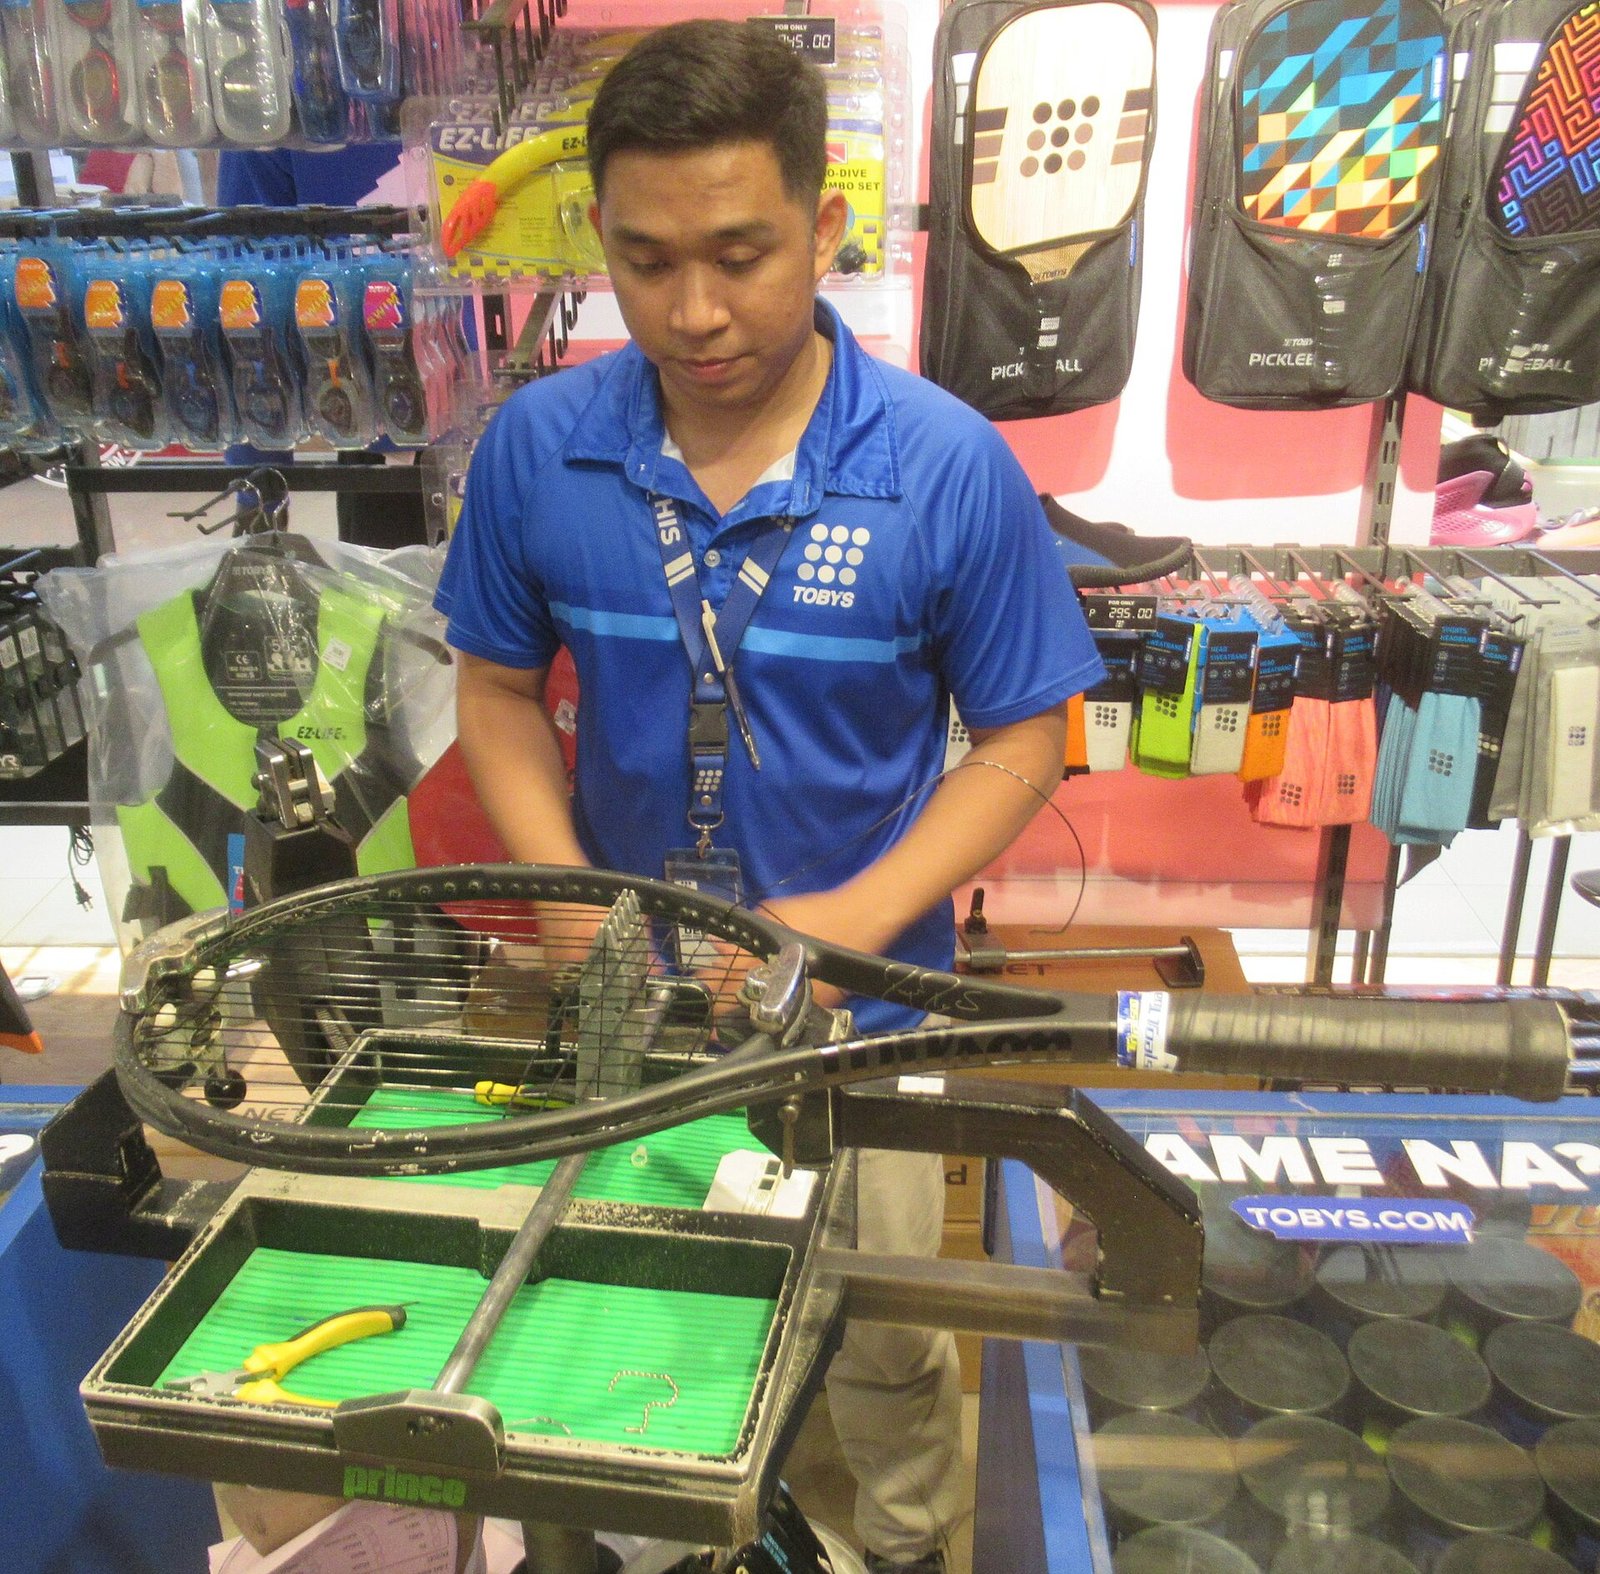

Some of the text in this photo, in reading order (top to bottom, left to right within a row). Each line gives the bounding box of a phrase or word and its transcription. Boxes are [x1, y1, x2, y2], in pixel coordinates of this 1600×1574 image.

[774, 23, 808, 31] FOR ONLY
[858, 181, 881, 191] SET
[654, 491, 681, 546] HIS
[792, 585, 856, 609] TOBYS
[1108, 607, 1153, 620] 295.00
[1247, 1206, 1468, 1232] TOBYS.COM
